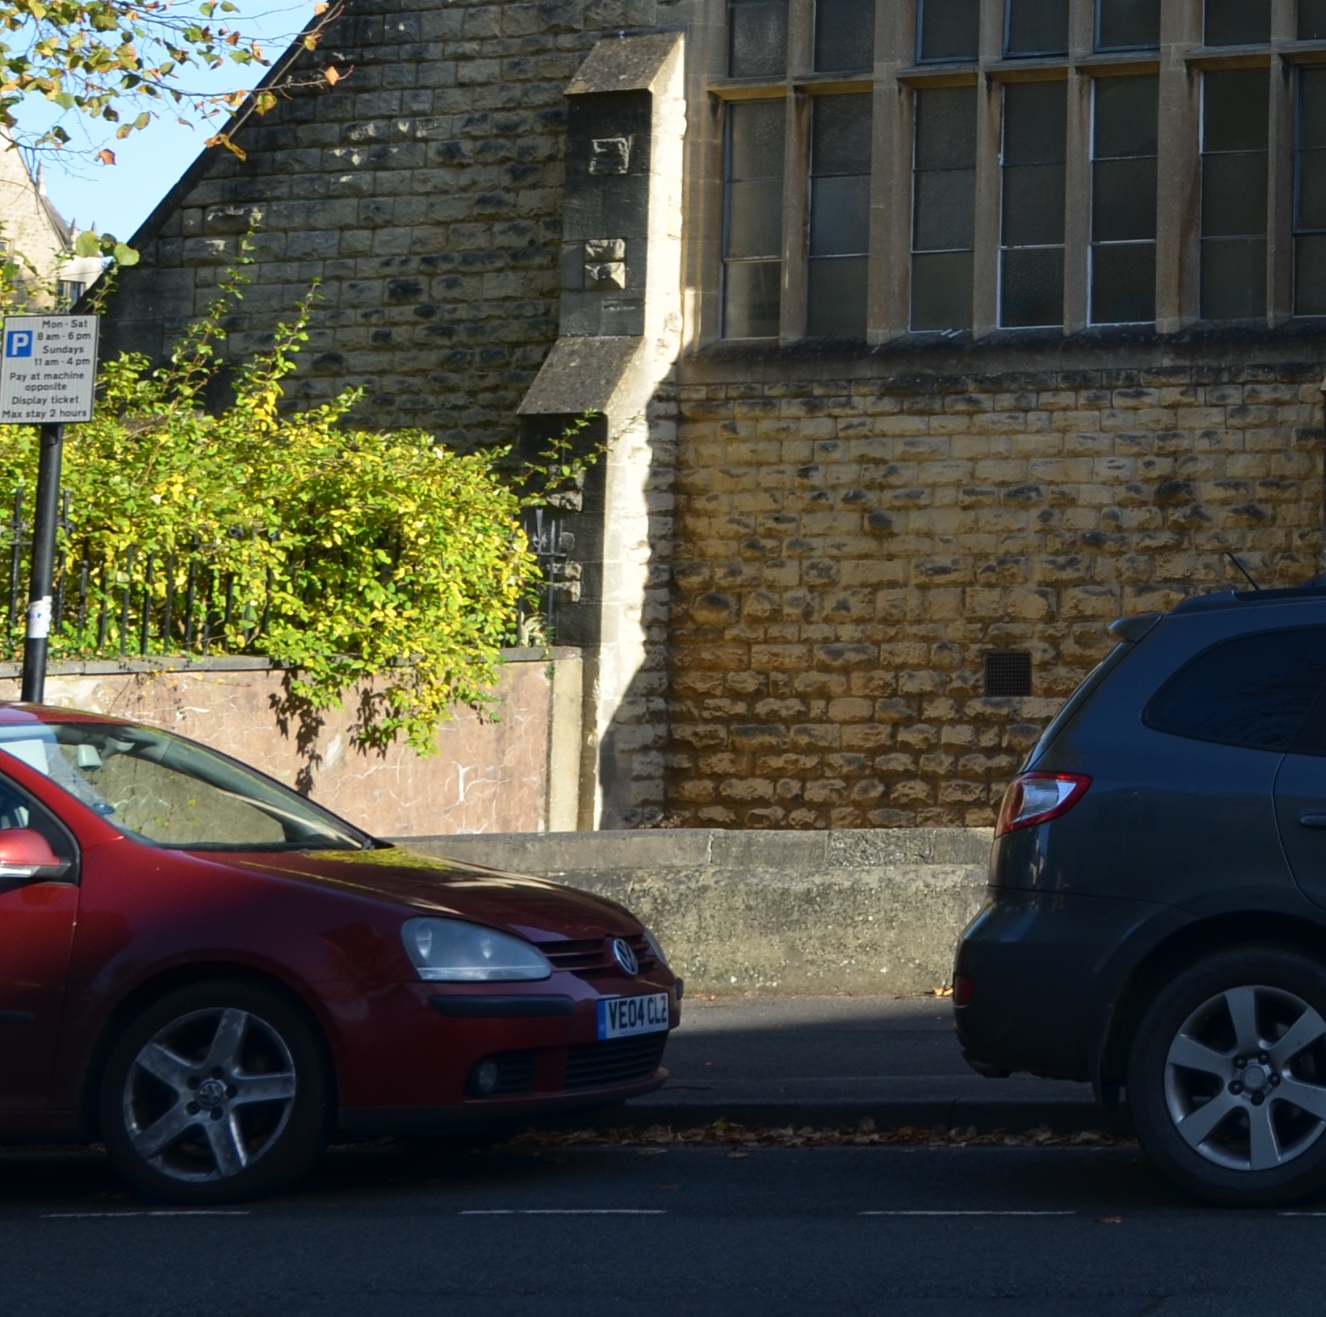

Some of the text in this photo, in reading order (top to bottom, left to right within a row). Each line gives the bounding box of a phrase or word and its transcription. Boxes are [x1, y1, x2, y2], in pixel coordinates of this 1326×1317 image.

[42, 320, 63, 329] Mon
[71, 319, 88, 328] Sat
[37, 332, 44, 341] 8
[45, 333, 60, 341] am
[68, 332, 74, 340] 6
[76, 333, 91, 341] pm
[42, 345, 84, 355] Sundays
[34, 358, 42, 366] 11
[44, 358, 59, 366] am
[66, 357, 73, 365] 4
[75, 358, 91, 366] pm
[10, 372, 84, 382] Pay at machine
[25, 383, 67, 392] opposite
[11, 395, 79, 406] Display ticket
[1, 409, 87, 420] Max stay 2 hours
[608, 995, 667, 1030] VE04 CLZ
